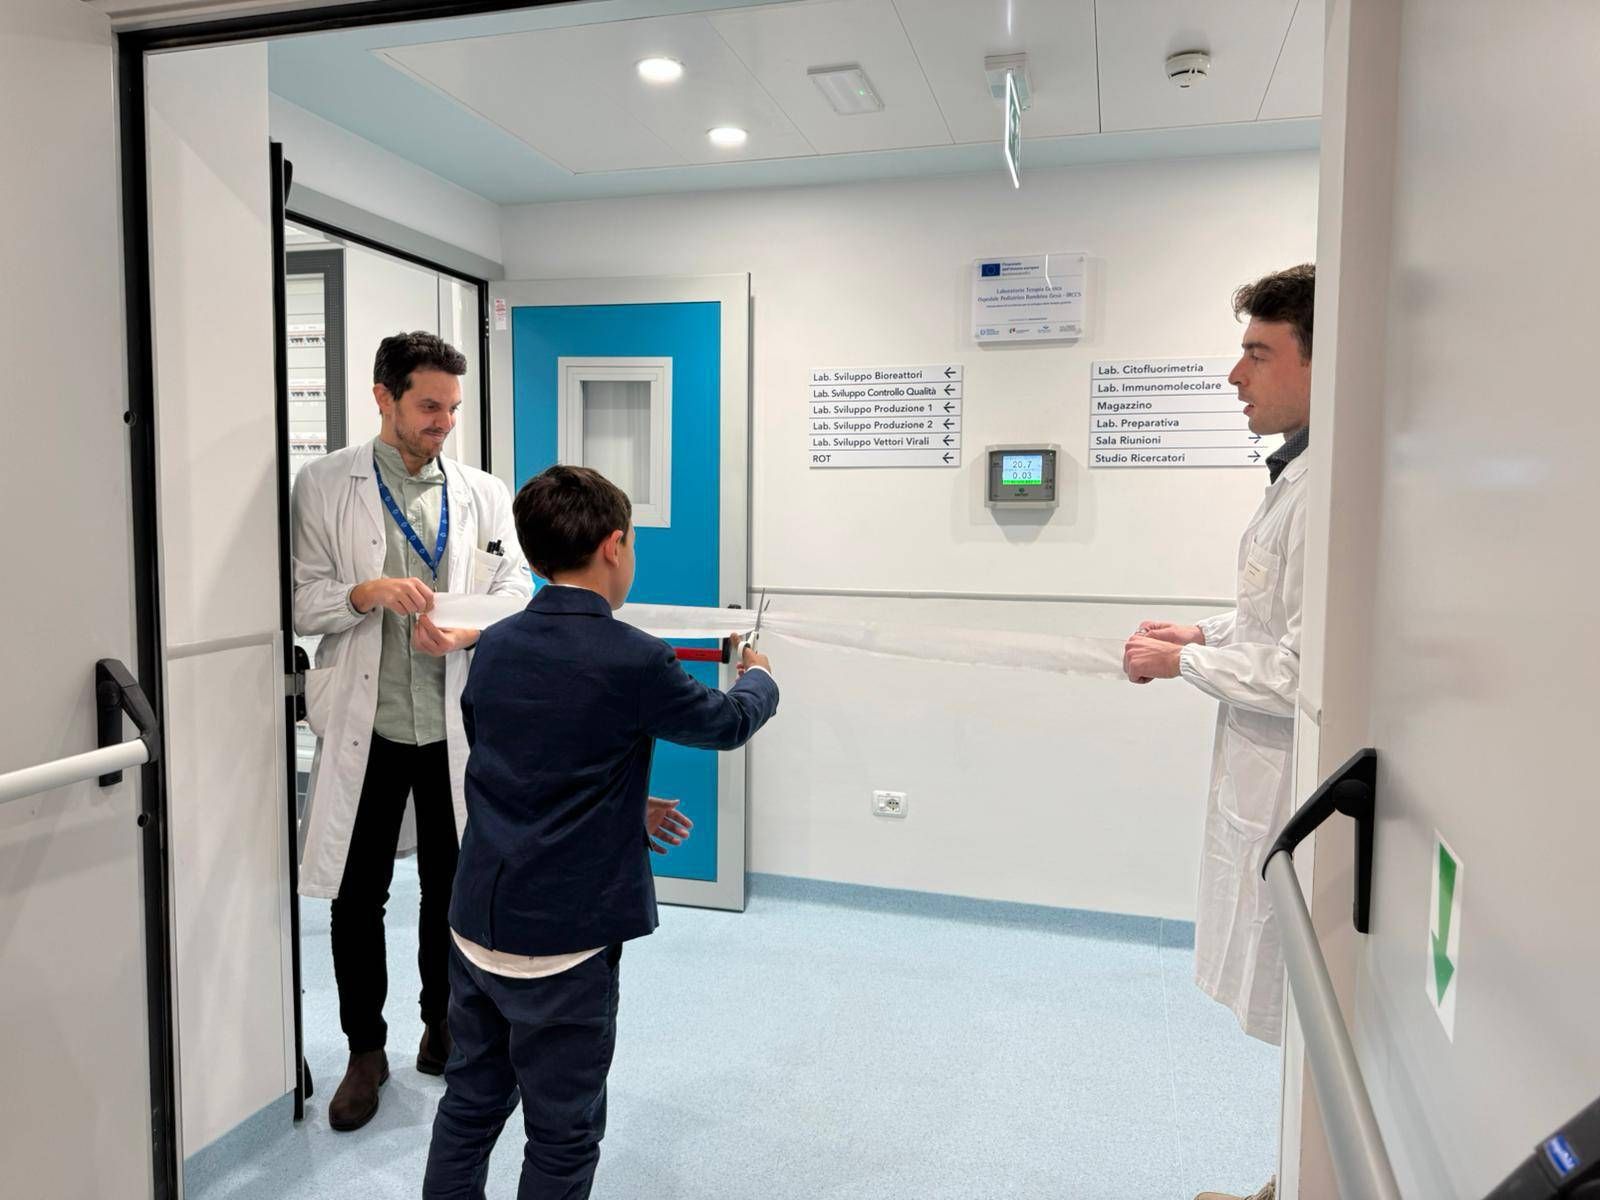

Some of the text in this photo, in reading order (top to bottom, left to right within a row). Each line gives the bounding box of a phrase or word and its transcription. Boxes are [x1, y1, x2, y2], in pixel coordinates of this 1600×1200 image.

[1098, 363, 1204, 375] Lab. Citofluorimetria
[813, 370, 922, 382] Lab. Sviluppo Bioreattori
[813, 386, 937, 398] Lab. Sviluppo Controllo Qualità
[1097, 381, 1222, 393] Lab. Immunomolecolare
[813, 404, 933, 415] Lab. Sviluppo Produzione 1
[1097, 400, 1152, 412] Magazzino
[813, 420, 933, 431] Lab. Sviluppo Produzione 2
[1096, 418, 1180, 429] Lab. Preparativa
[812, 436, 930, 448] Lab. Sviluppo Vettori Virali
[1095, 435, 1161, 445] Sala Riunioni
[812, 454, 831, 463] ROT
[1095, 453, 1185, 463] Studio Ricercatori
[1012, 460, 1032, 468] 20.7
[1012, 471, 1032, 479] 0.03
